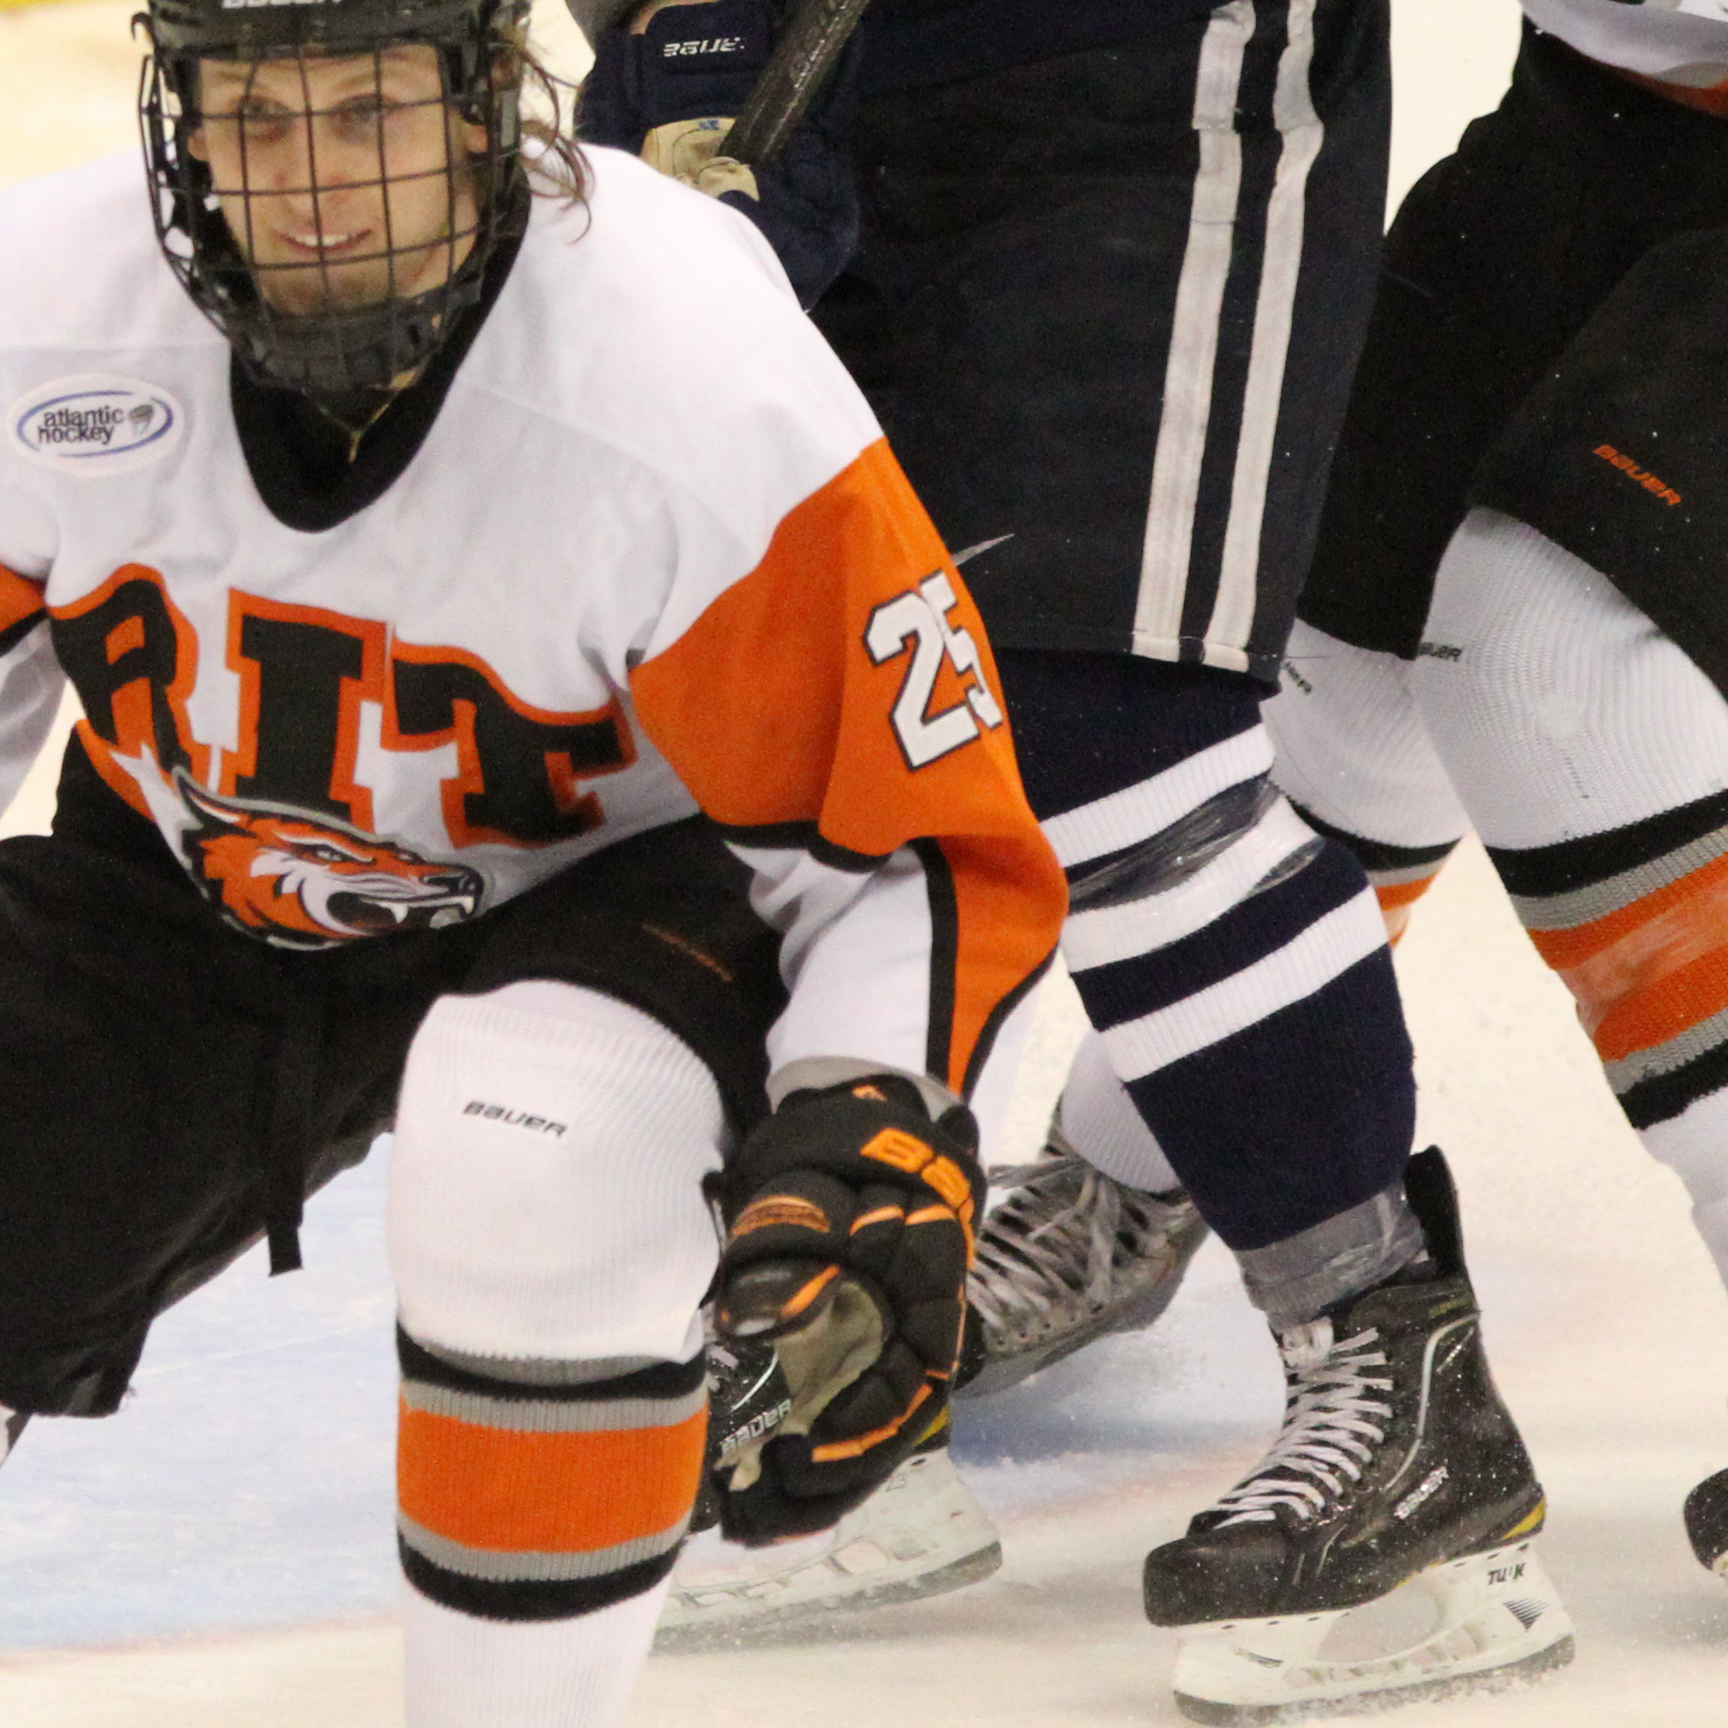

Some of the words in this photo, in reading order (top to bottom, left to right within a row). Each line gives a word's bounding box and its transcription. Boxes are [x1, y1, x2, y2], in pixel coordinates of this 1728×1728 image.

[43, 404, 125, 429] atlantic
[37, 424, 115, 446] hockey
[44, 562, 638, 852] RIT
